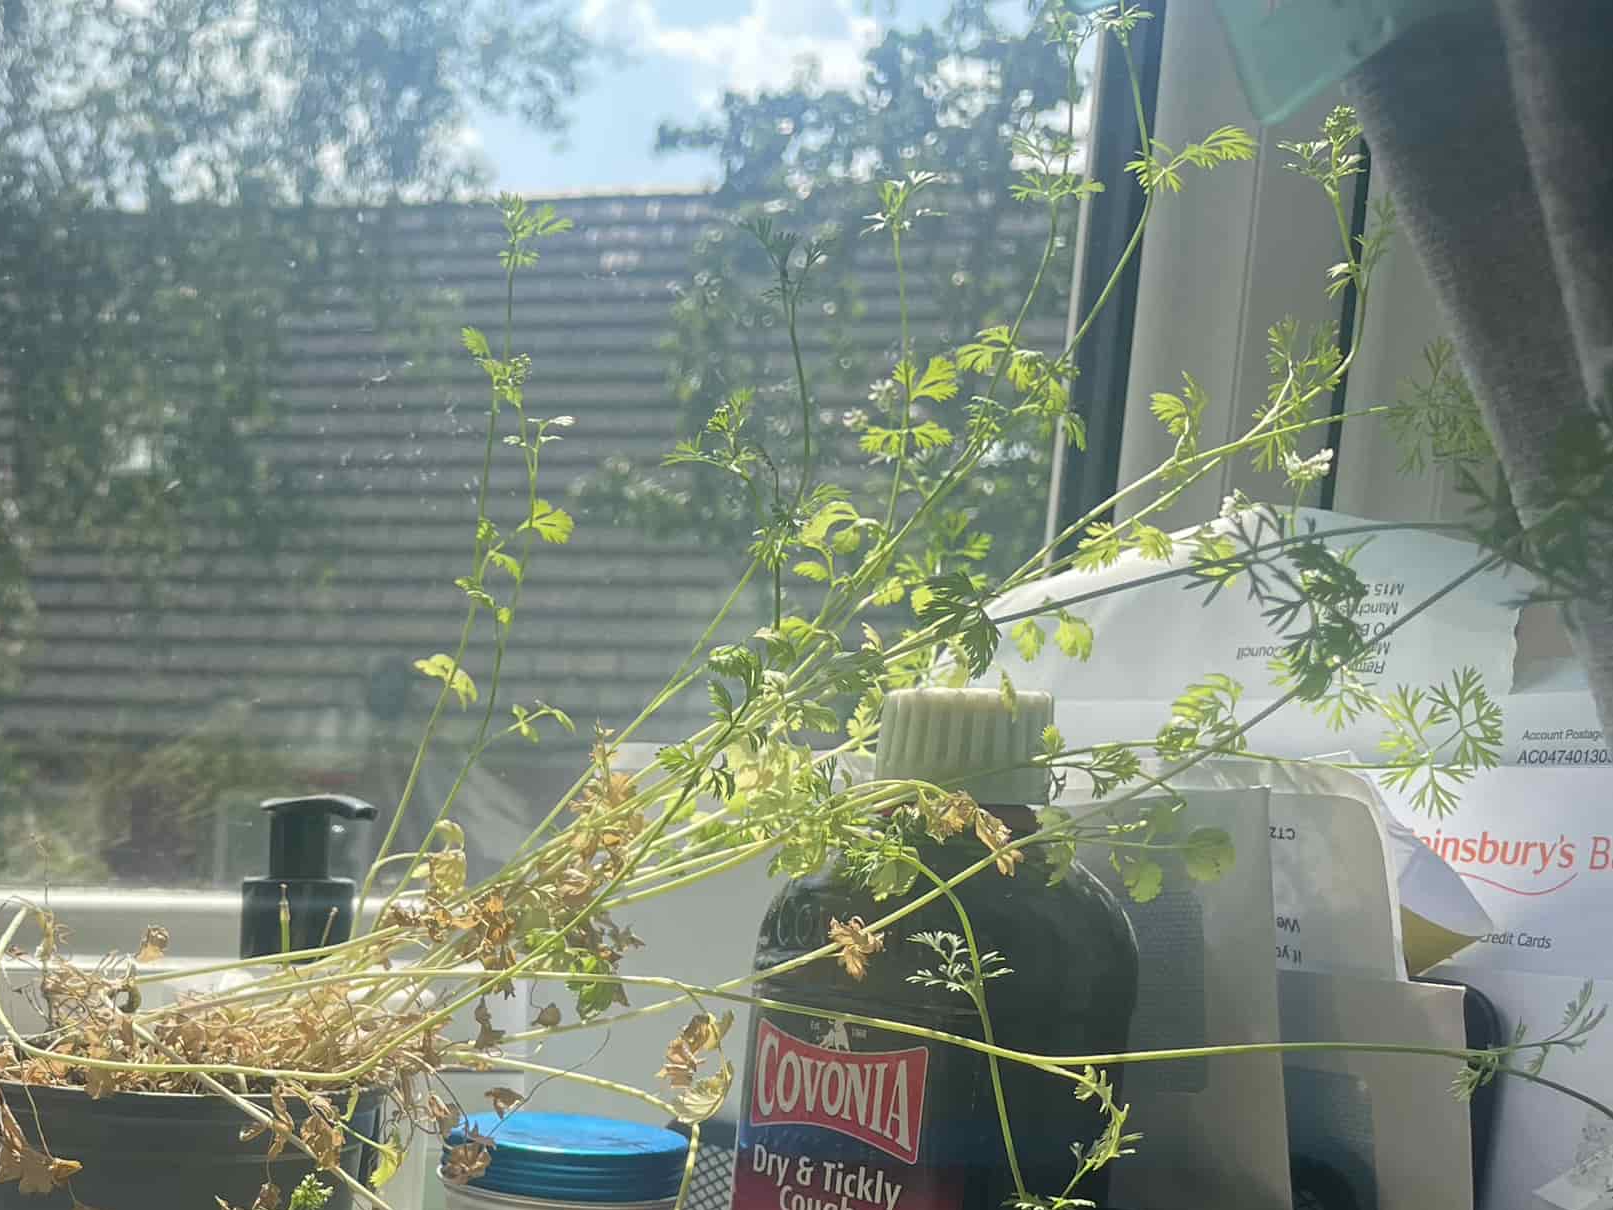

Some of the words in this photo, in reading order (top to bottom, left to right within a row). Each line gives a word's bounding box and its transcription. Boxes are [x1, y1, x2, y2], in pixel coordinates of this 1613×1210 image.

[1522, 729, 1563, 742] Account
[1565, 728, 1605, 743] Postag
[1517, 749, 1613, 764] AC04740130
[1413, 830, 1576, 875] insbury's
[1517, 932, 1552, 949] Cards
[757, 1031, 913, 1152] COVONIA
[752, 1143, 790, 1187] Dry
[795, 1155, 815, 1186] &
